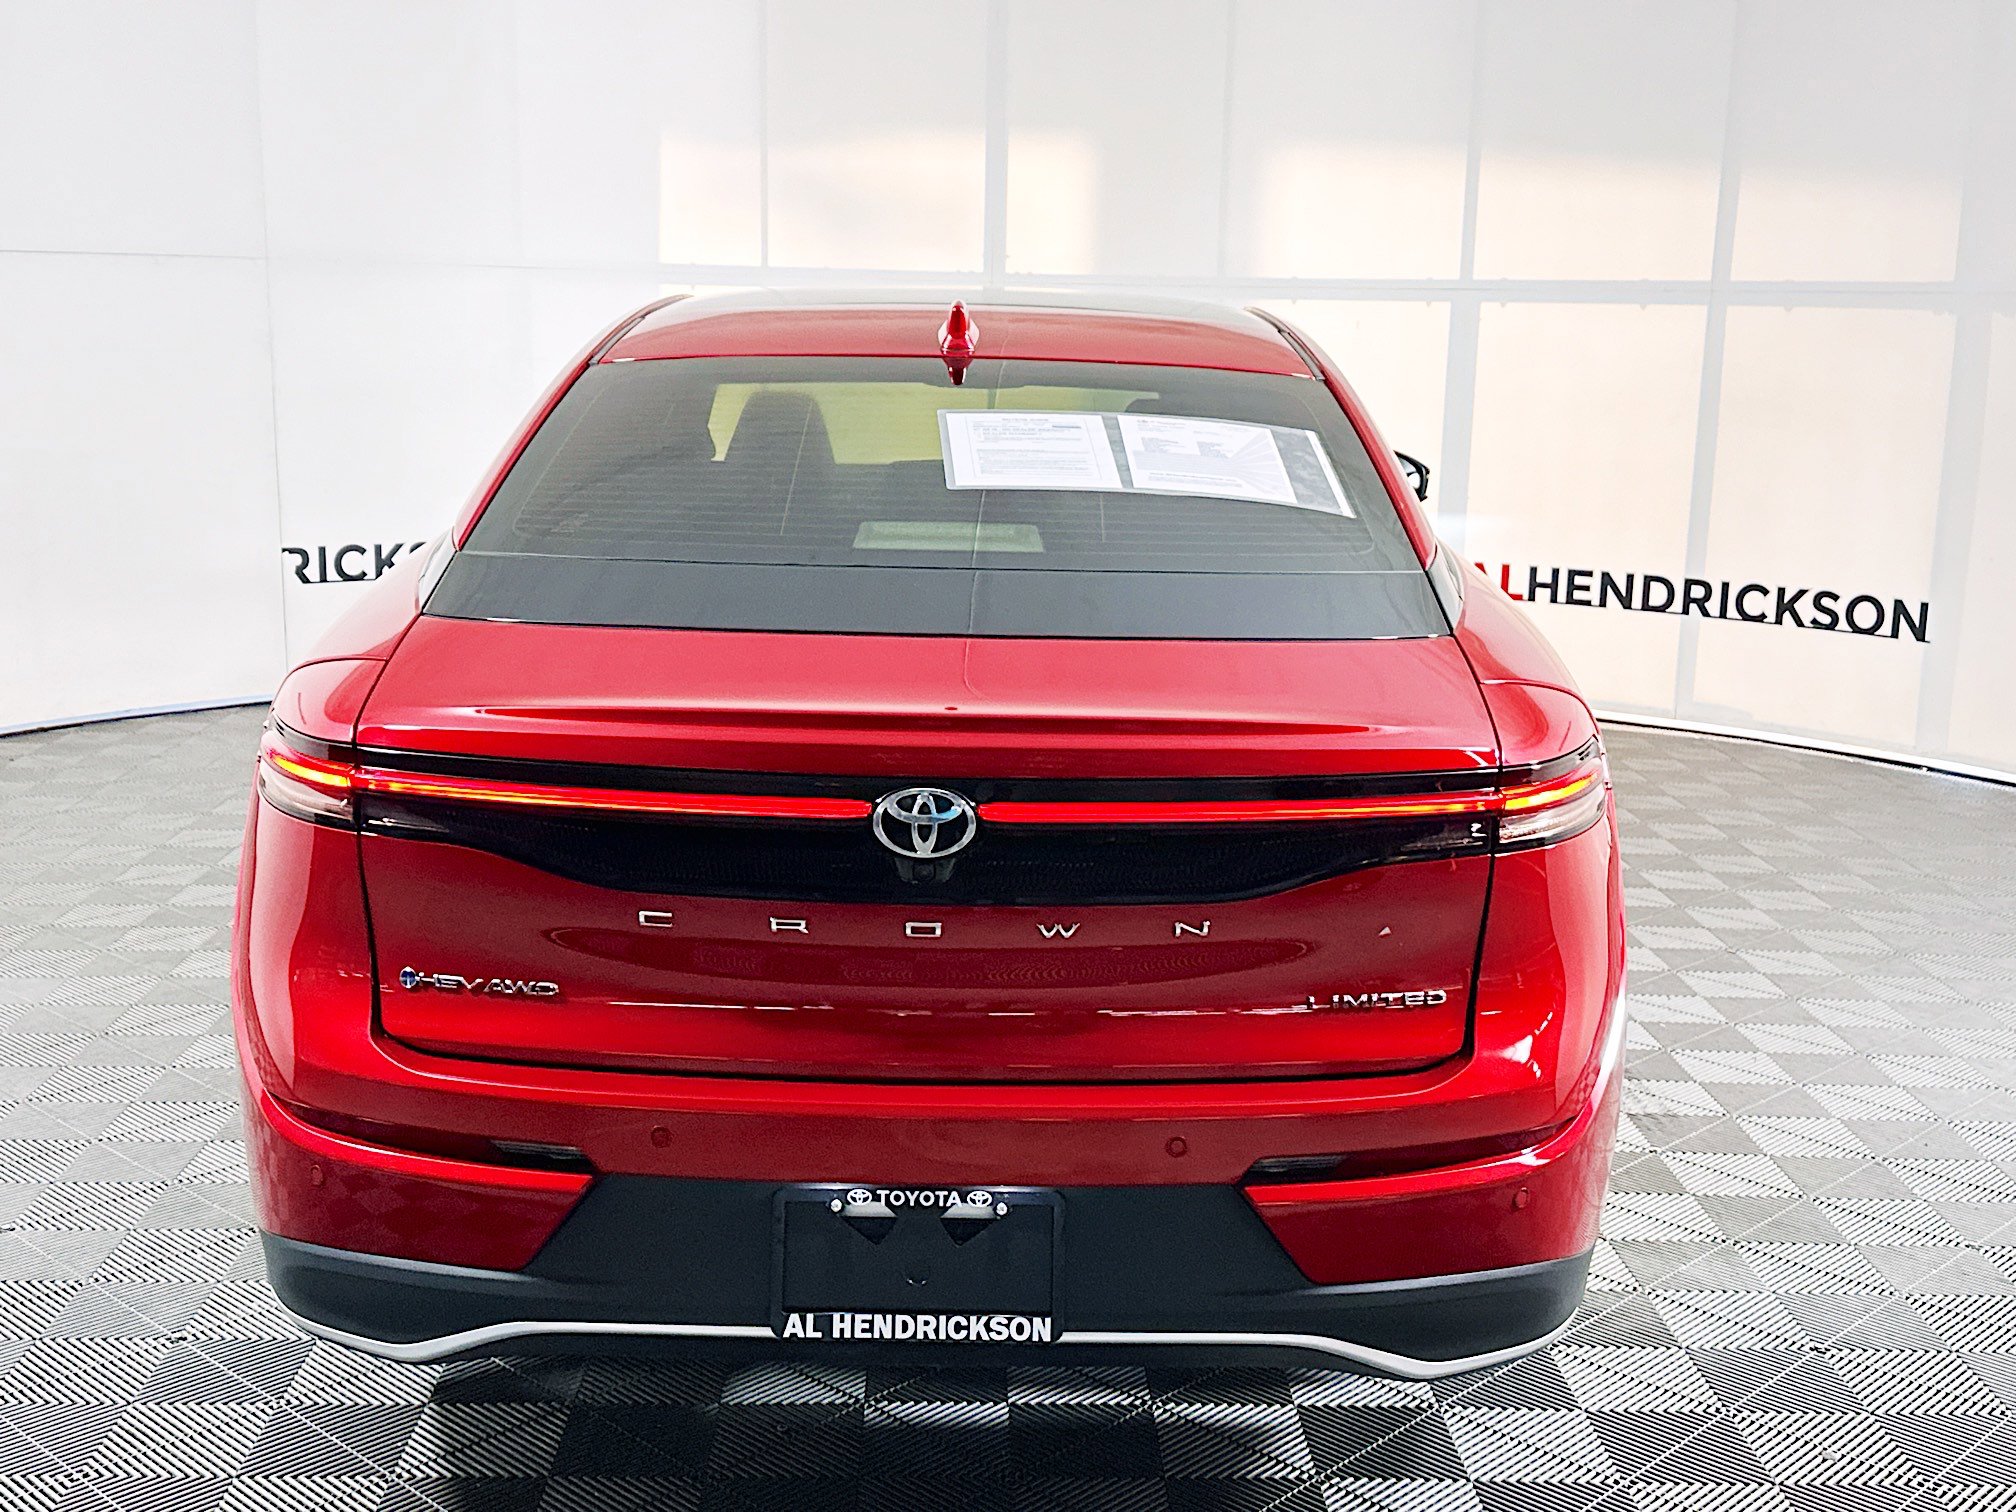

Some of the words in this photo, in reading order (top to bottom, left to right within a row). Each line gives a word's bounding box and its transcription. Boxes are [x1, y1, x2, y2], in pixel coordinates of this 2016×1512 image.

[638, 910, 1211, 939] CROWN
[414, 971, 484, 990] HEV
[483, 978, 560, 996] AWD
[1306, 989, 1448, 1010] LIMITED
[876, 1189, 963, 1207] TOYOTA
[783, 1313, 822, 1339] AL
[832, 1313, 1052, 1342] HENDRICKSON
